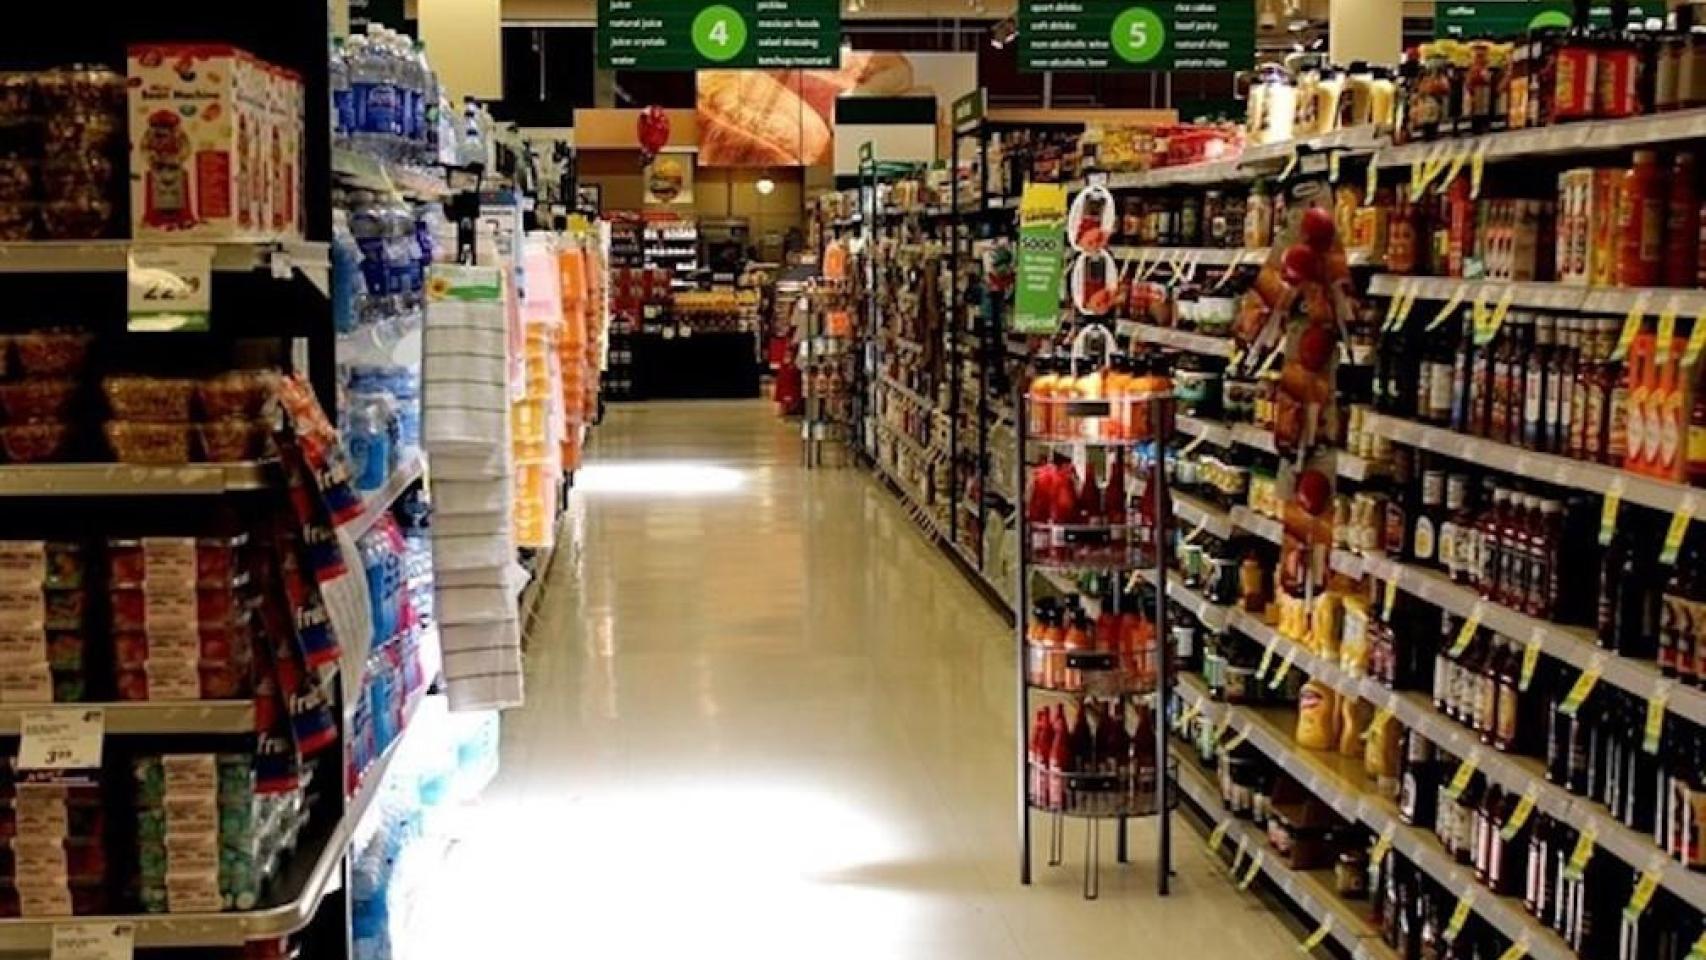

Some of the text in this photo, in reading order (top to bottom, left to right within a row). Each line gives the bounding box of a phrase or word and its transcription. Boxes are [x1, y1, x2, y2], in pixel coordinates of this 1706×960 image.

[1055, 2, 1083, 13] drinks
[609, 17, 663, 31] natural juice
[758, 18, 820, 28] mexican foods
[1030, 20, 1077, 31] soft drinks
[1174, 20, 1219, 33] beef jerky
[707, 19, 729, 46] 4
[1129, 22, 1148, 48] 5
[609, 36, 632, 48] juice
[758, 36, 819, 49] salad dressing
[1207, 39, 1230, 50] chips
[611, 56, 636, 65] water
[1174, 57, 1228, 69] potato chips
[173, 90, 220, 99] Machine
